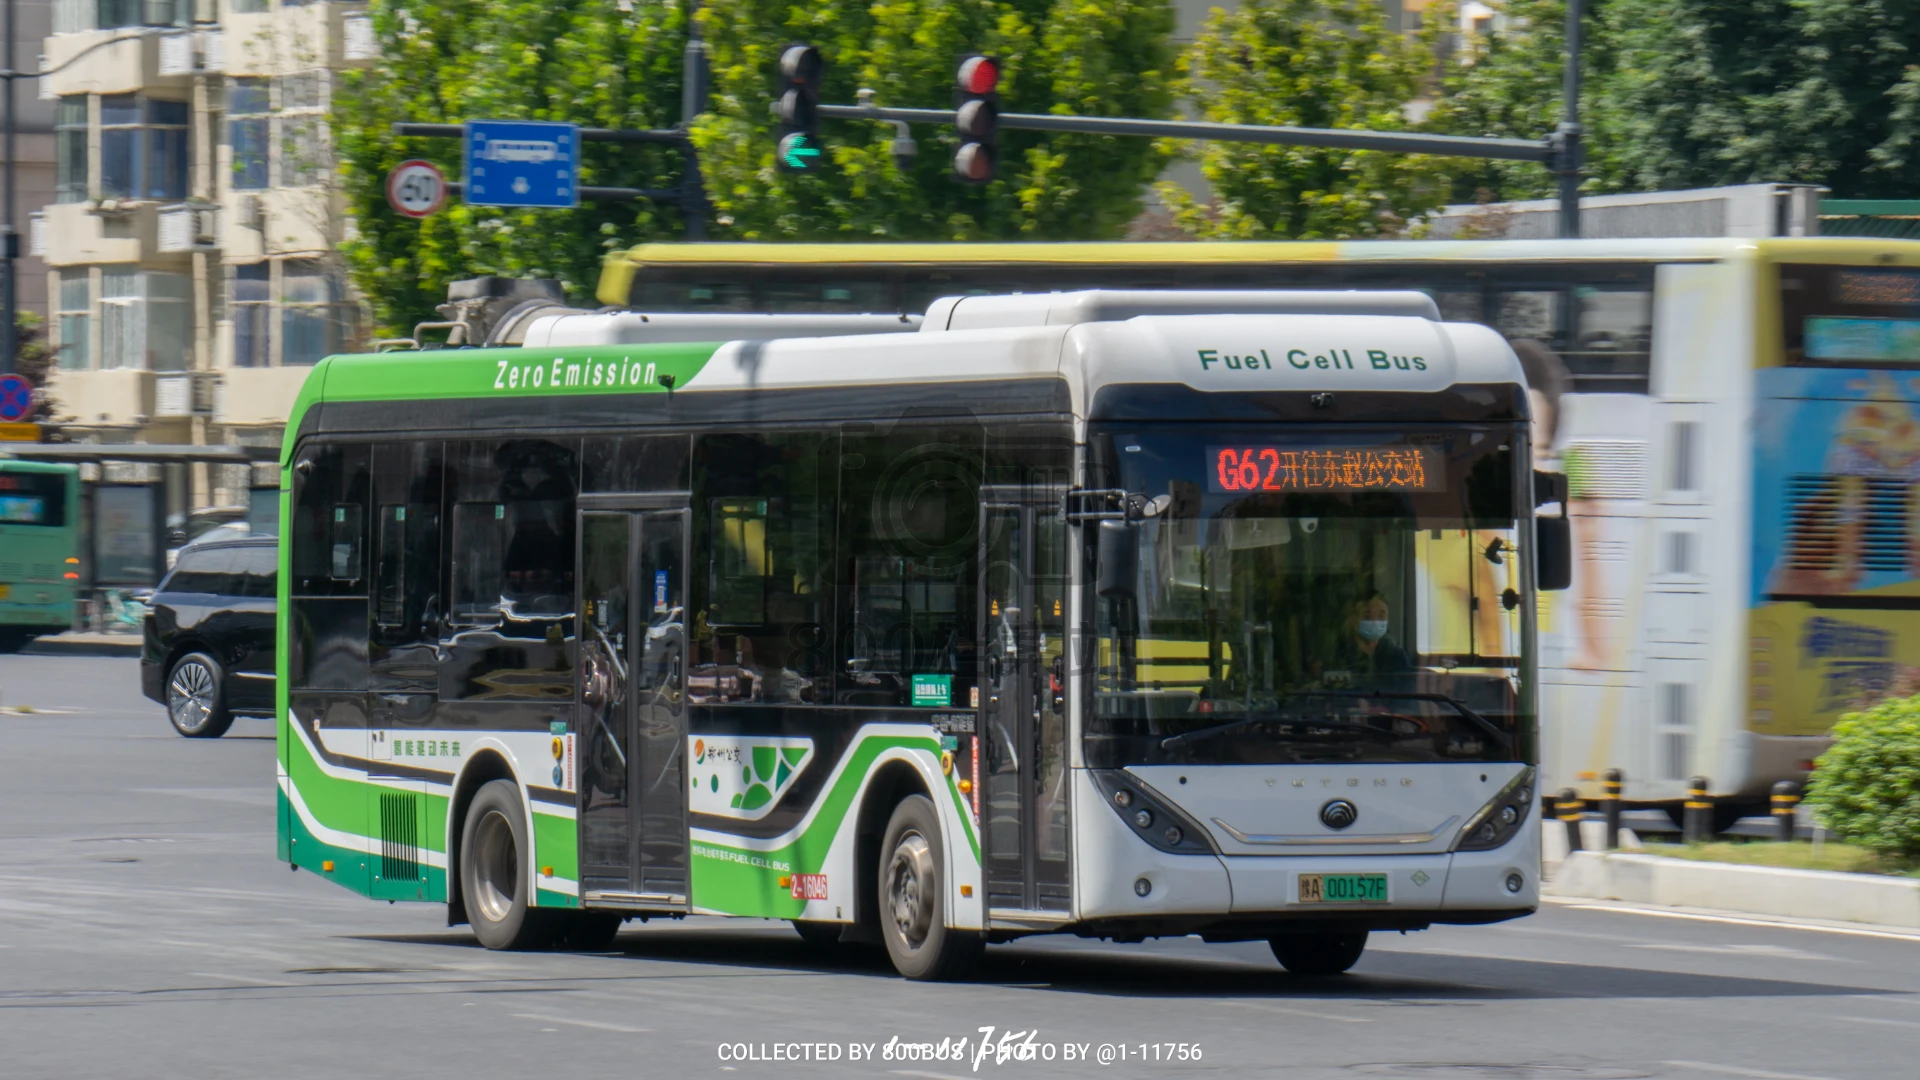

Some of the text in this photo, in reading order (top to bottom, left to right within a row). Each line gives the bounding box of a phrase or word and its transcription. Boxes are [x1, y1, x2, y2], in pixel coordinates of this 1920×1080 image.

[1198, 349, 1428, 371] Fuel Cell Bus
[494, 356, 656, 389] Zero Emission
[1217, 449, 1281, 490] G62
[729, 851, 749, 865] FUEL
[751, 856, 771, 869] CELL
[772, 861, 790, 872] BUS
[791, 874, 827, 898] 2-16046
